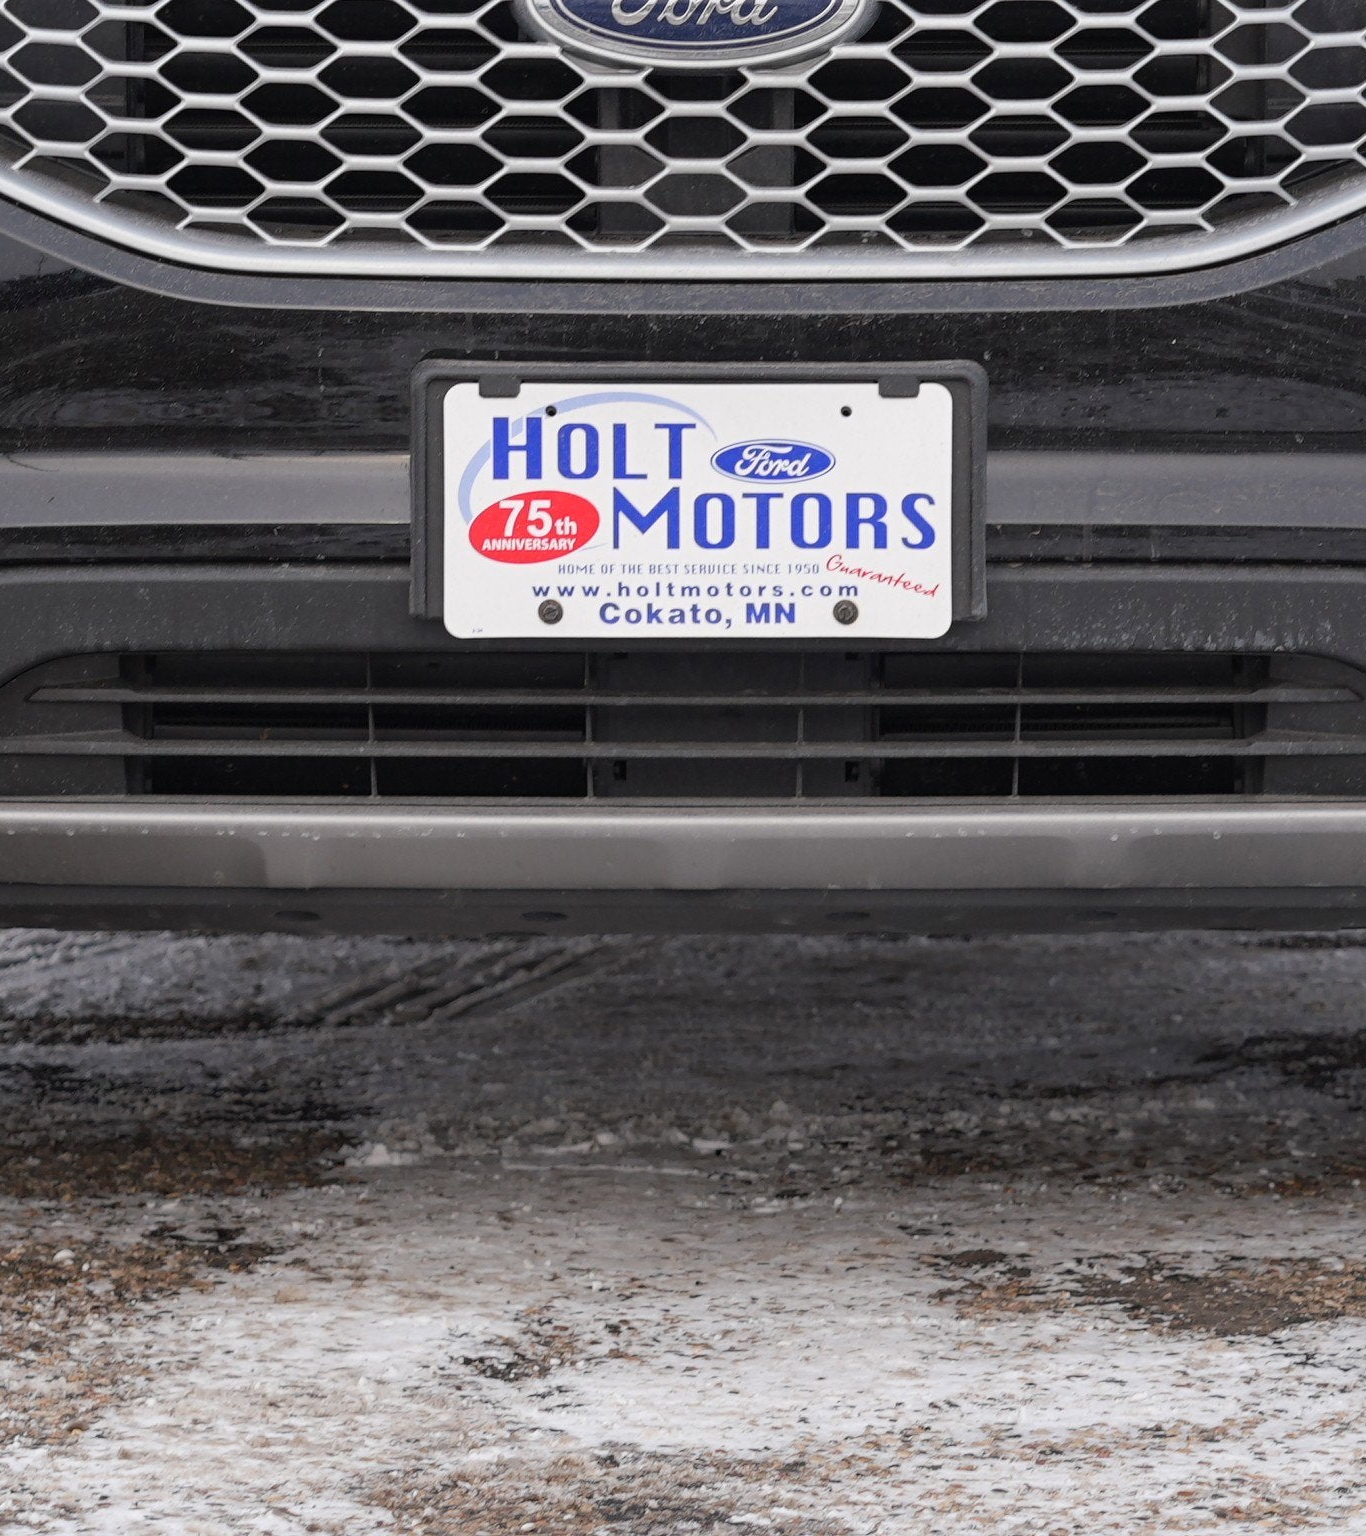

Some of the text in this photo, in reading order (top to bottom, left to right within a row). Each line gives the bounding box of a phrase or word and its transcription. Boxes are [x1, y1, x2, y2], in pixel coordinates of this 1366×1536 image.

[492, 416, 697, 481] HOLT
[734, 443, 812, 478] Ford
[498, 498, 579, 539] 75th
[612, 485, 936, 551] MOTORS
[482, 537, 577, 552] ANNIVERSARY
[558, 563, 820, 575] HOME OF THE BEST SERVICE SINCE 1950
[826, 554, 940, 598] Guaranteed
[532, 581, 859, 598] www.holtmotors.com
[599, 602, 796, 629] Cokato, MN
